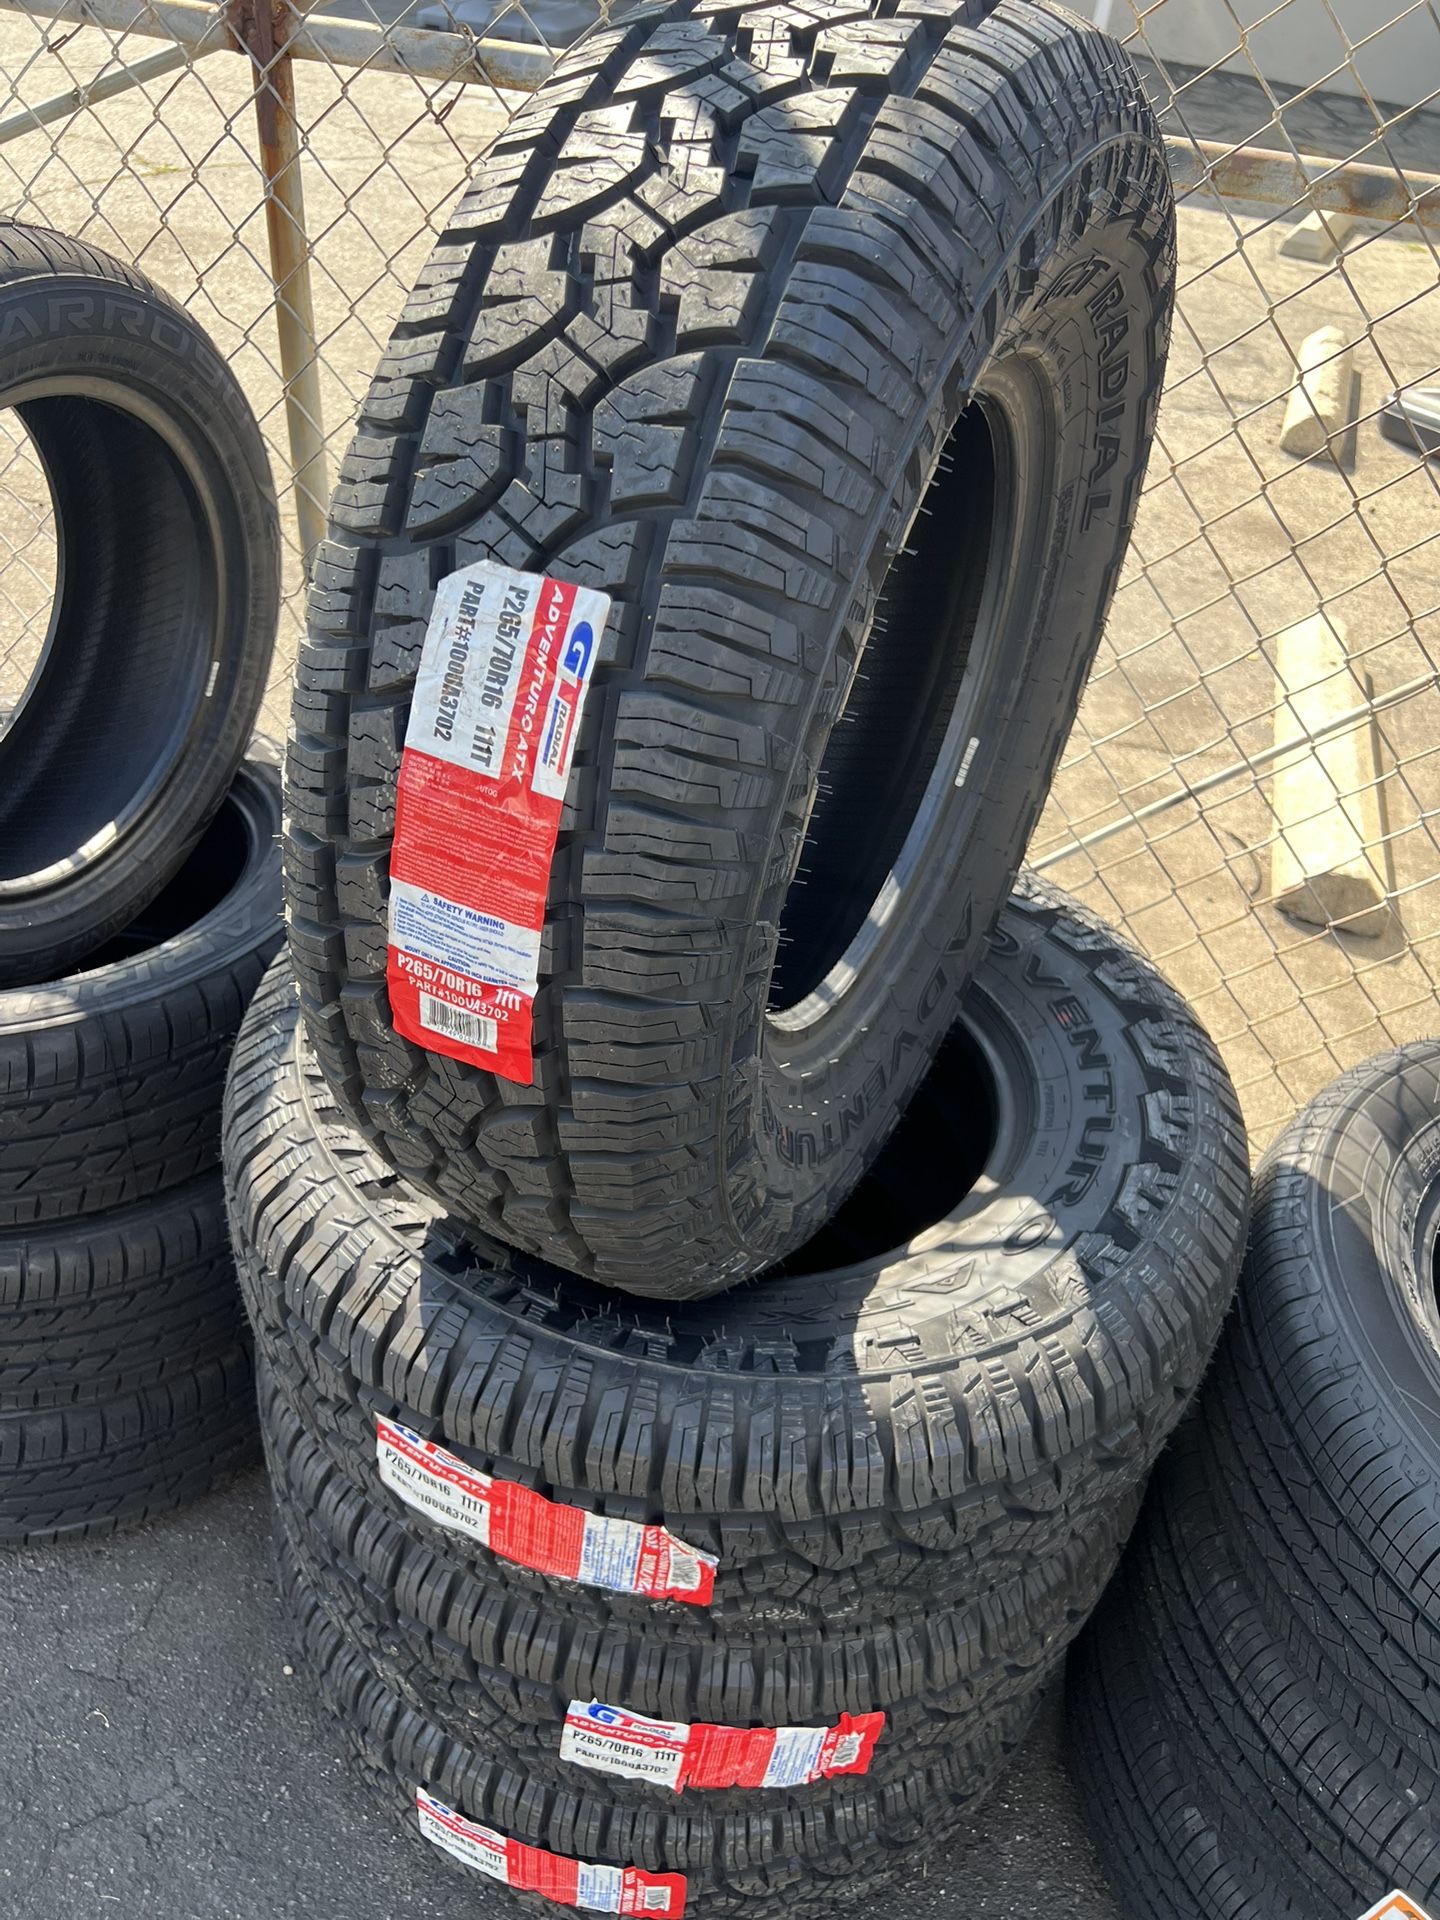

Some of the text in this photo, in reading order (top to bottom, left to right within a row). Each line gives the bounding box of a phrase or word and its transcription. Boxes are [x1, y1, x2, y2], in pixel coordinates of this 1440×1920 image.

[1081, 271, 1131, 534] RADIAL
[470, 585, 530, 768] P265/70R16 111T
[511, 584, 564, 784] ADVENTURO ATX
[548, 704, 571, 768] RADIAL
[433, 897, 463, 917] SAFETY
[464, 911, 505, 931] WARNING
[398, 953, 522, 1011] P265/70R16 111T
[987, 916, 1114, 1257] DVENTURO
[458, 1477, 488, 1496] ATX
[460, 1494, 485, 1515] 111T
[569, 1717, 655, 1743] ADVENTURO
[573, 1730, 678, 1762] P265/70R16 111T
